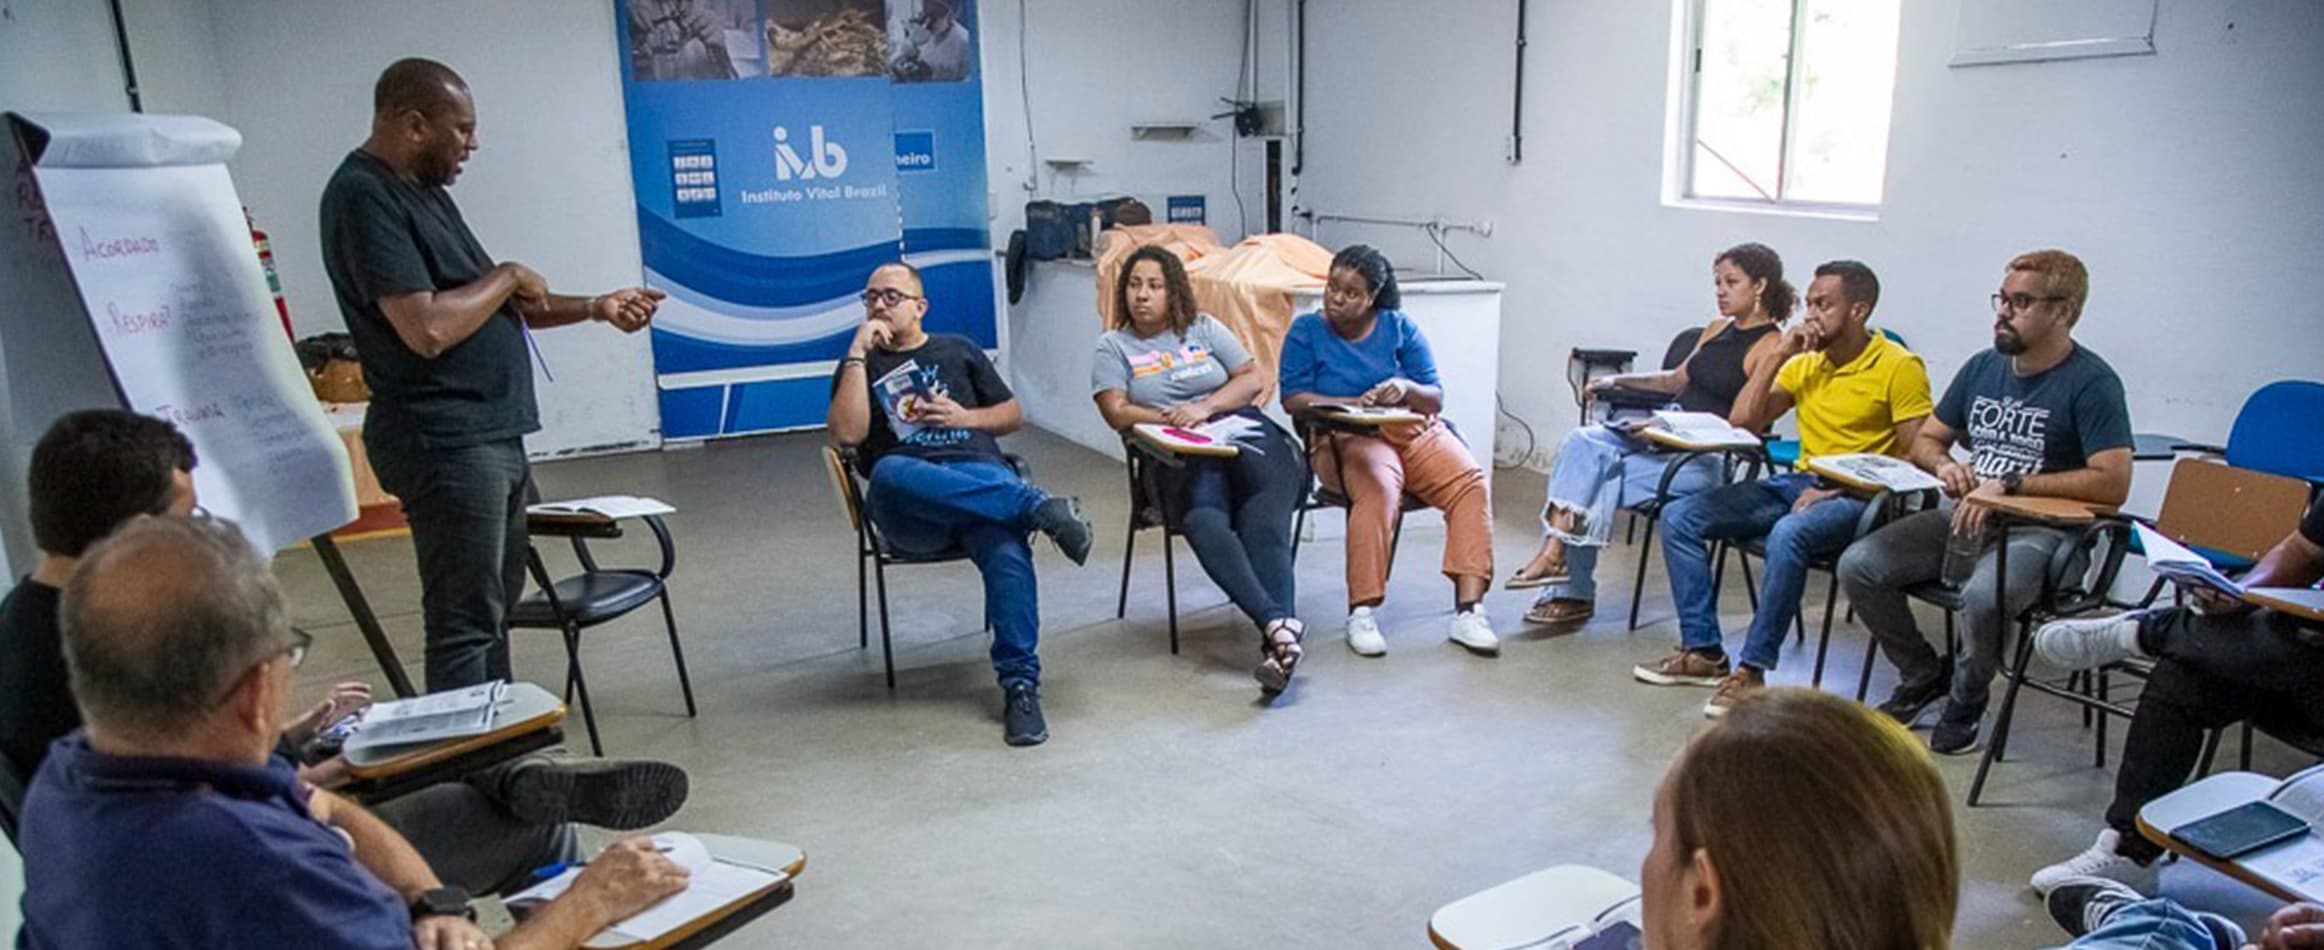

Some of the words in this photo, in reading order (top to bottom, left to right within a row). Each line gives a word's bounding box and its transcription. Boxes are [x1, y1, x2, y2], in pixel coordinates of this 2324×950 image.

[742, 187, 802, 204] Instituto
[806, 184, 841, 199] Vital
[845, 183, 887, 198] Brazil
[1968, 400, 2050, 438] FORTE
